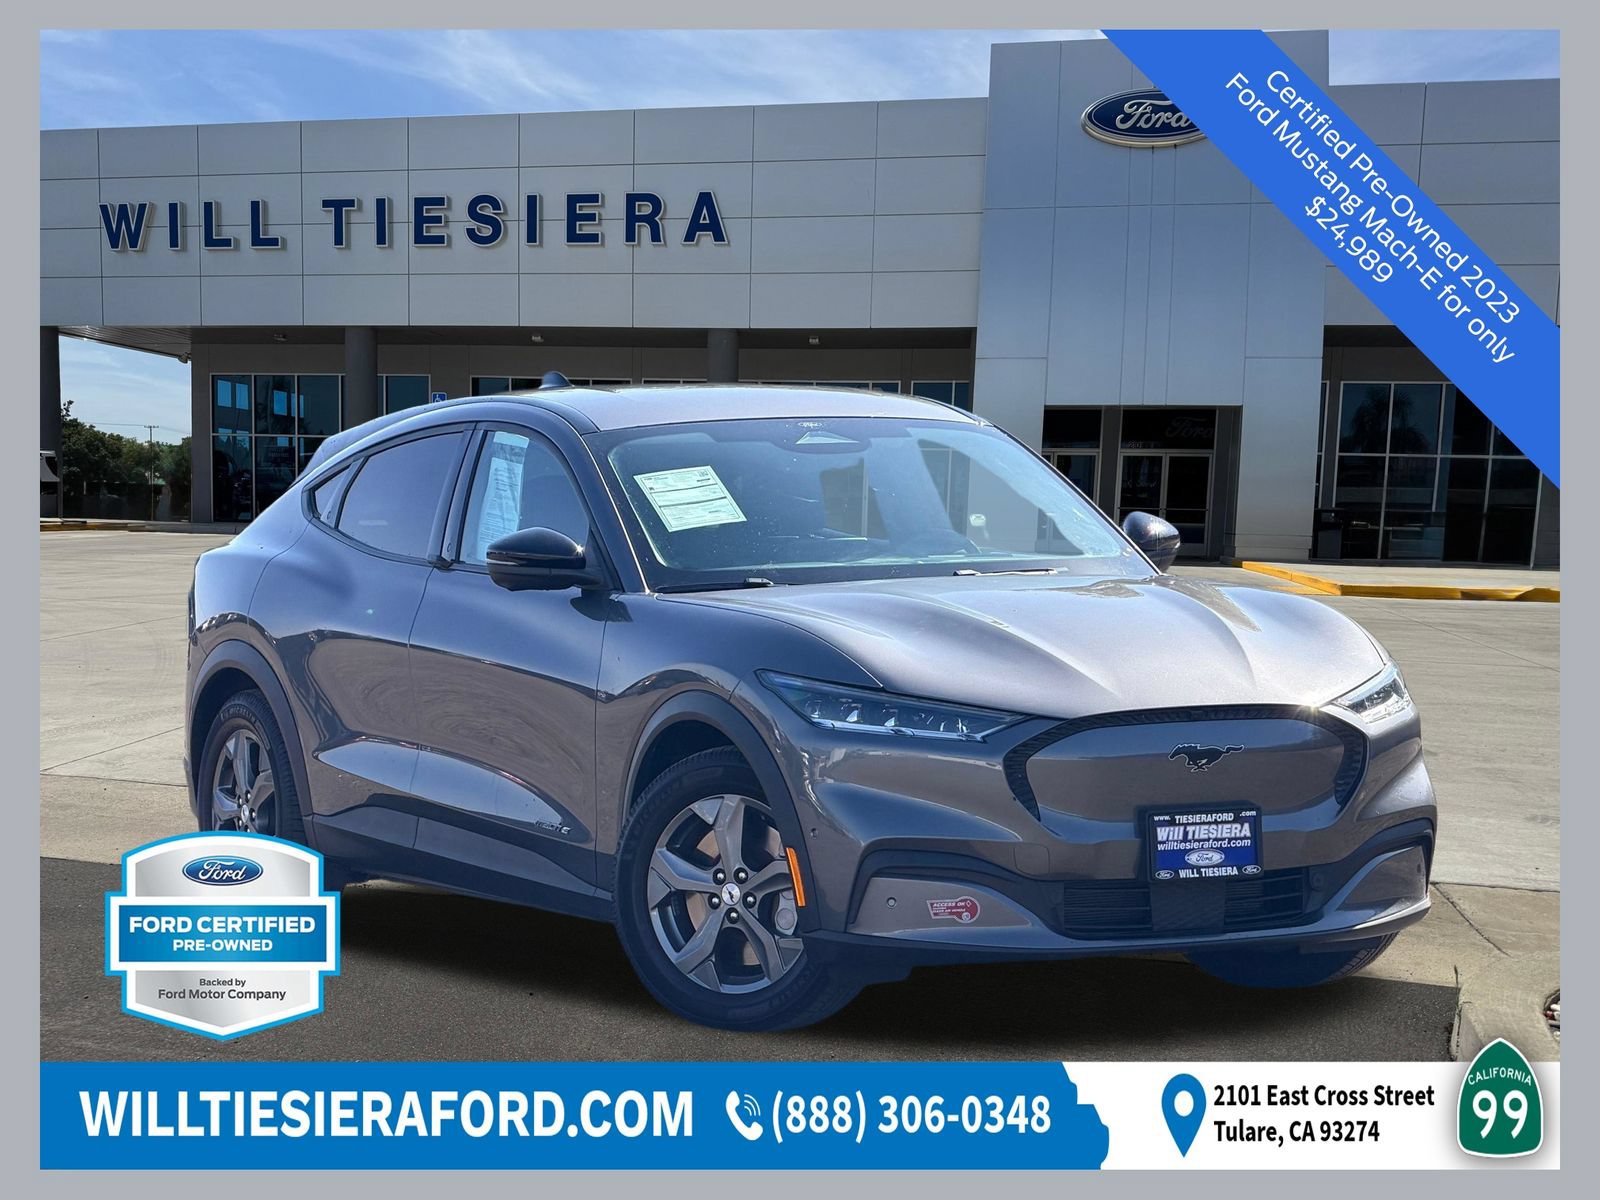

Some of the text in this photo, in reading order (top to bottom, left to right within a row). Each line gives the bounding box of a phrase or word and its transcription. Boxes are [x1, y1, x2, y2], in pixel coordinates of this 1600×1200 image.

[98, 191, 729, 251] WILL TIESIERA
[1175, 813, 1234, 824] TIESIERAFORD
[1156, 823, 1251, 841] Will TIESIERA
[1158, 839, 1251, 850] willtiesieraford.com
[1179, 867, 1238, 878] WILL TIESIERA
